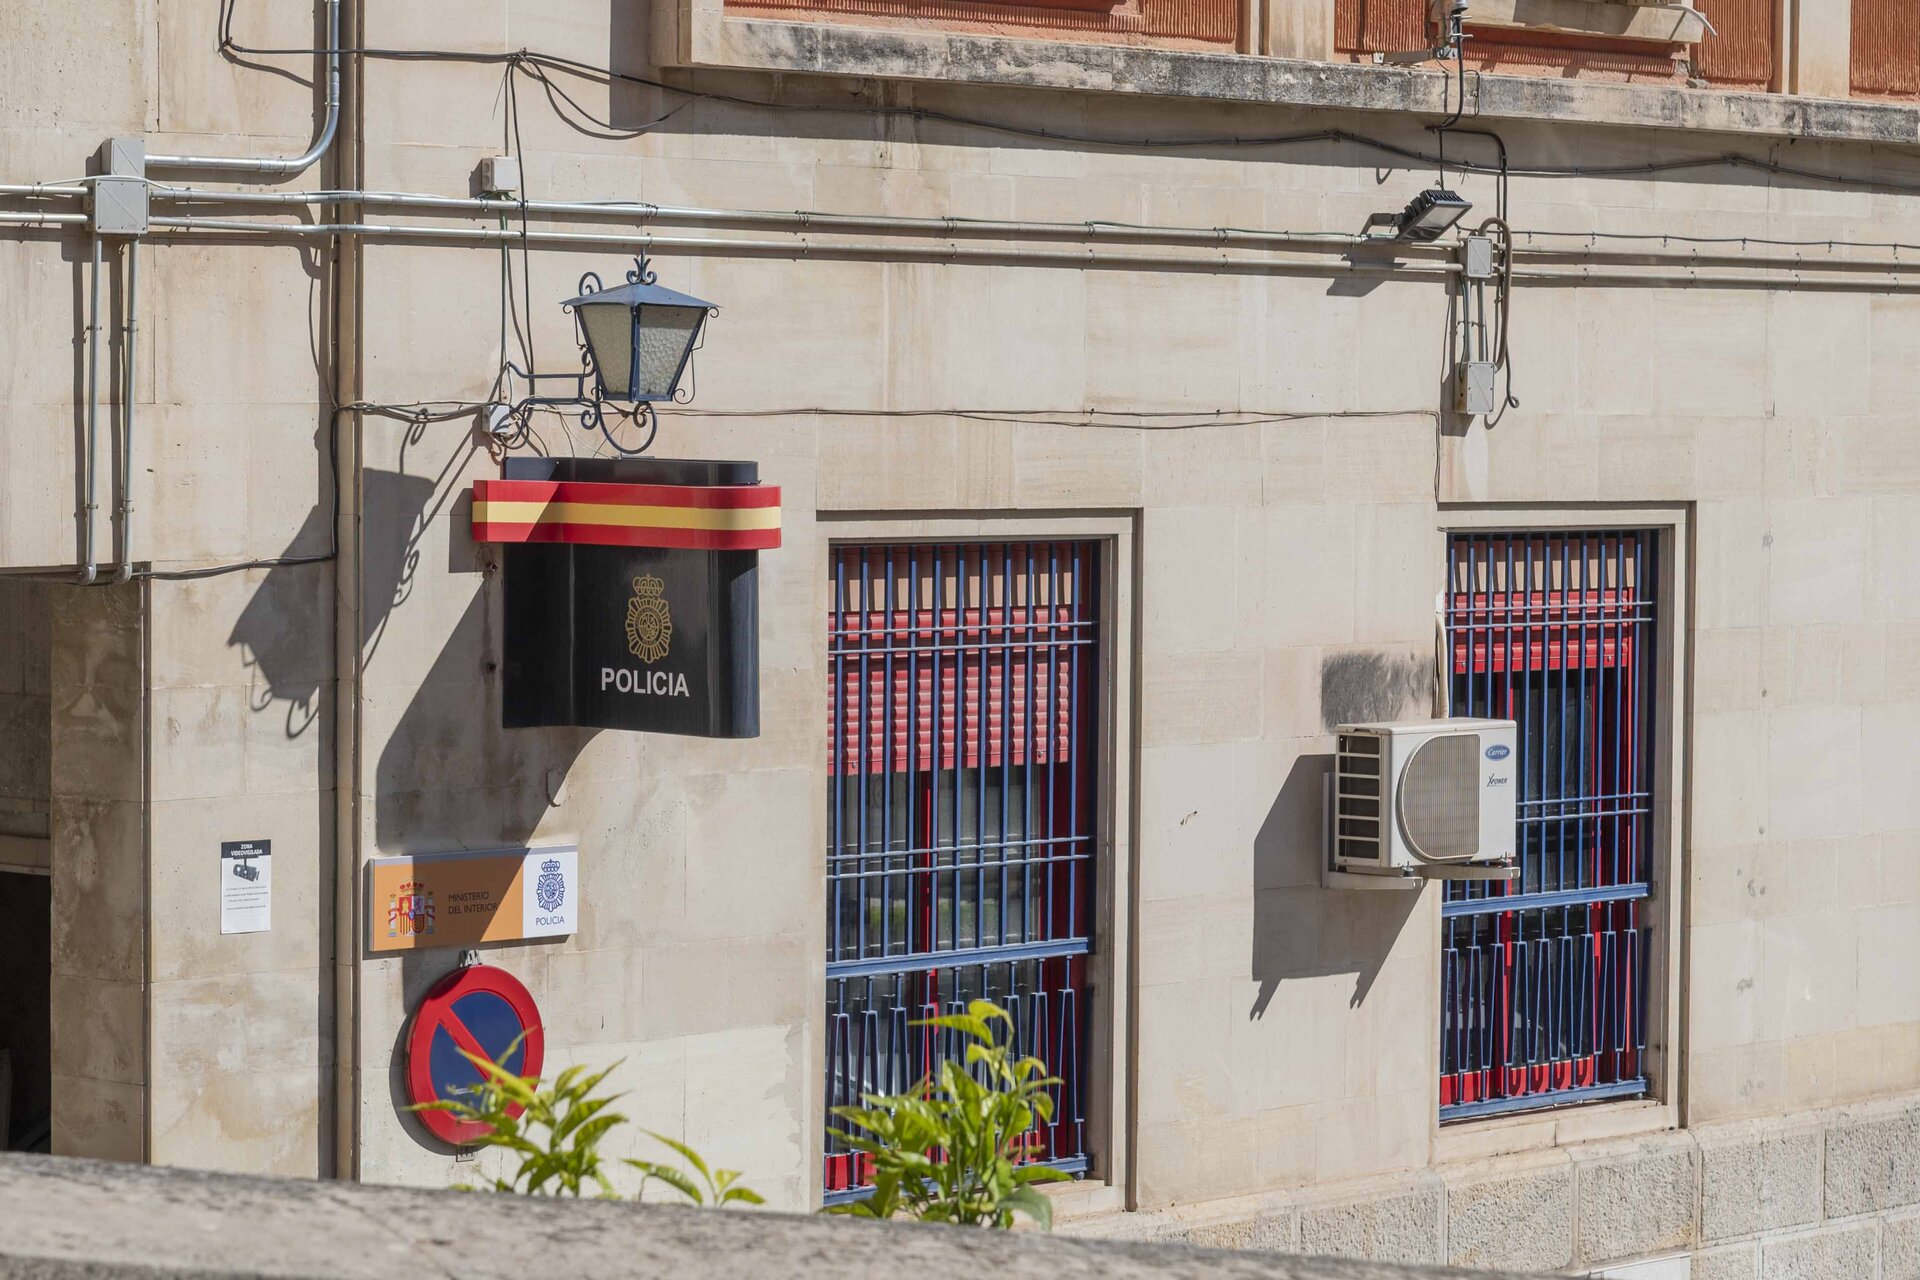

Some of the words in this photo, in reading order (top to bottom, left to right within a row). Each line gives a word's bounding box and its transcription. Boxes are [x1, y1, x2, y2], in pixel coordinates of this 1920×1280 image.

[601, 667, 690, 697] POLICIA
[448, 891, 489, 902] MINISTERIO
[448, 905, 462, 915] DEL
[463, 902, 498, 913] INTERIOR
[535, 916, 565, 926] POLICIA
